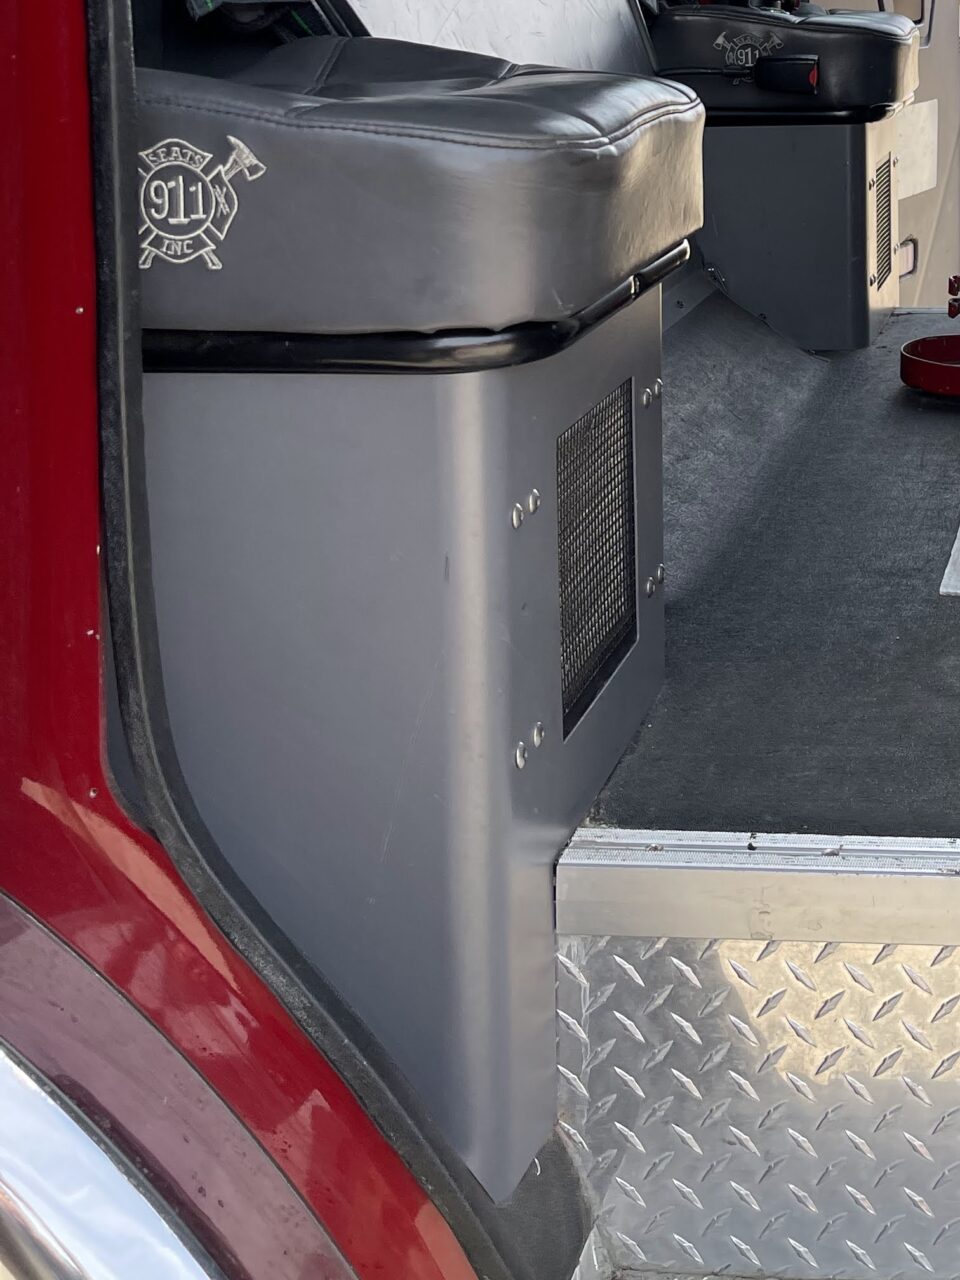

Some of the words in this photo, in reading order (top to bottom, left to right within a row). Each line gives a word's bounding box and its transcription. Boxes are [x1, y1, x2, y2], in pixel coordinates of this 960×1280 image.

[148, 147, 203, 167] SEATS
[150, 175, 207, 224] 911
[160, 239, 194, 255] INC
